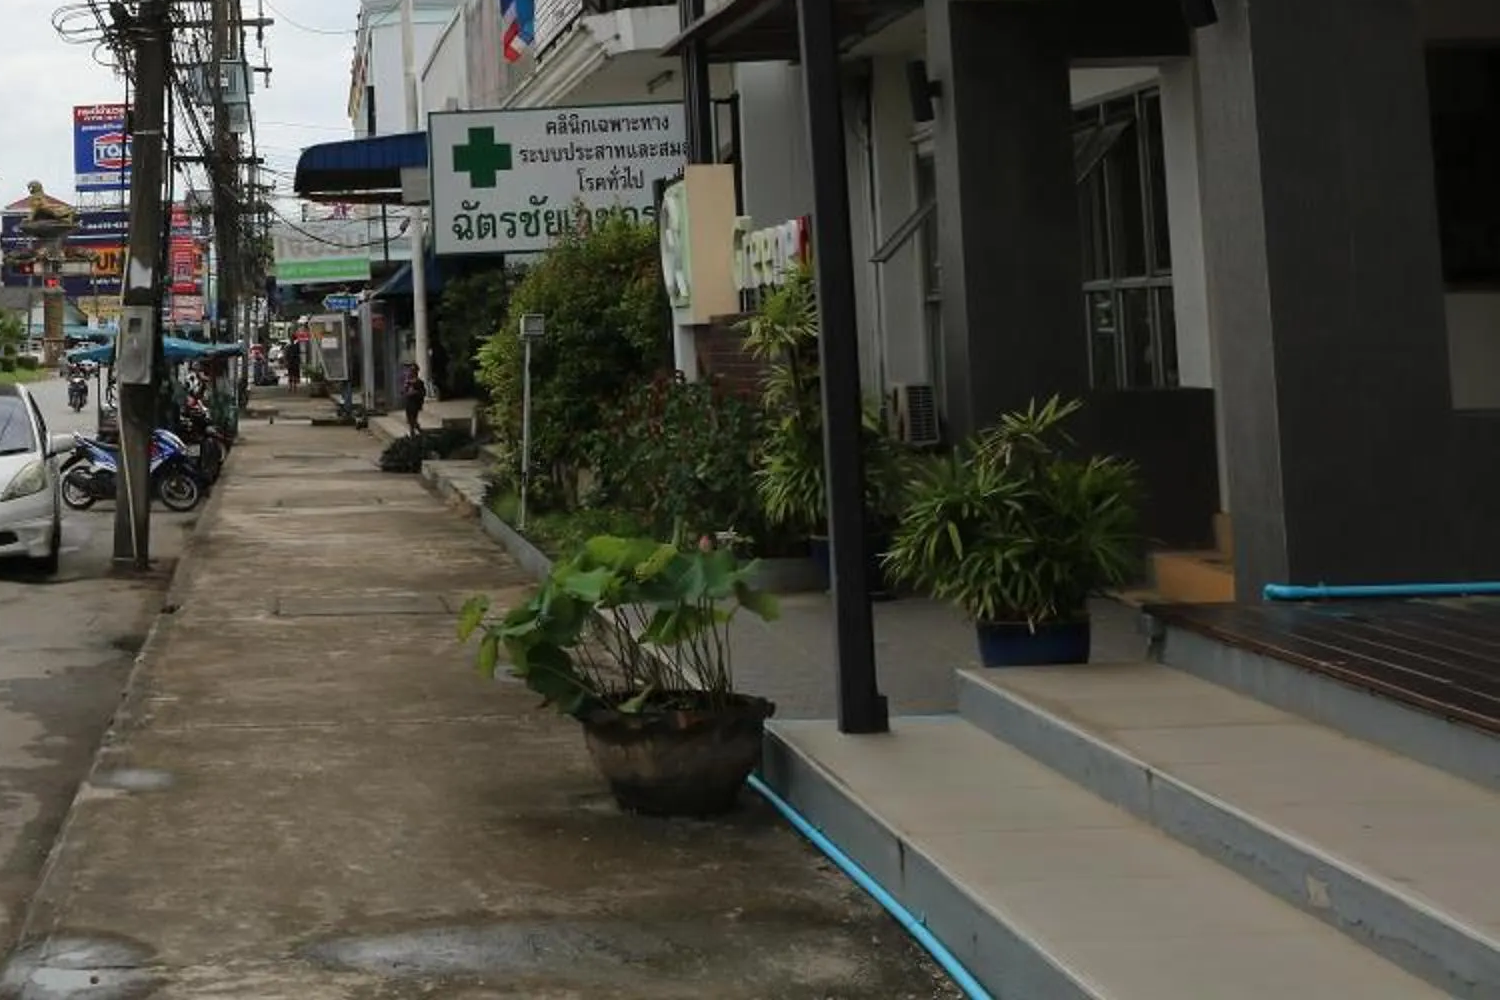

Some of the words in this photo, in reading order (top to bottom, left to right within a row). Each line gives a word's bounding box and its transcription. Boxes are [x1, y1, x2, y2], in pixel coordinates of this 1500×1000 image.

[545, 114, 669, 135] คลินิกเฉพาะทาง
[577, 165, 644, 192] โรคทั่วไป
